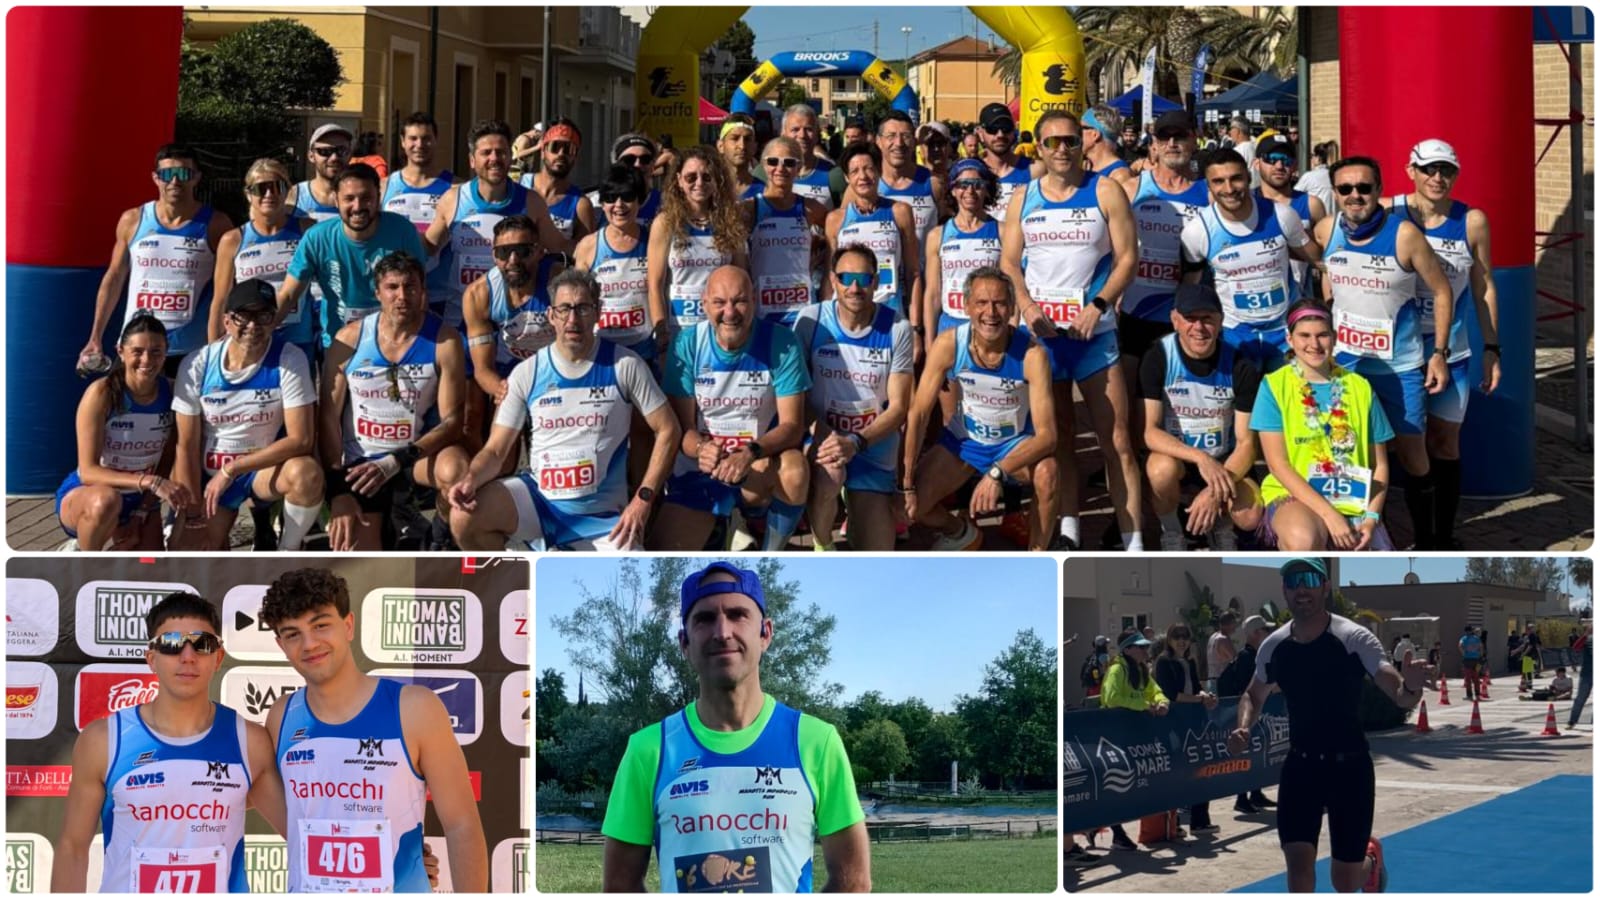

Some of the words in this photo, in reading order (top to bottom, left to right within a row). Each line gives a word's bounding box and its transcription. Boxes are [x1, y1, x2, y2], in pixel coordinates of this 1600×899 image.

[794, 52, 850, 62] BROOKS
[1028, 98, 1083, 113] Caraffa
[1138, 219, 1185, 235] Ranocc
[460, 237, 493, 248] Rano
[136, 255, 200, 270] Ranocchi
[239, 263, 290, 277] Ranoc
[1140, 263, 1180, 279] 102
[139, 293, 189, 311] 1029
[763, 288, 807, 304] 1022
[1246, 292, 1273, 309] 31
[599, 310, 645, 328] 1013
[1338, 327, 1389, 351] 1020
[819, 364, 882, 384] Ranocchi
[696, 394, 763, 407] Ranocchi
[537, 412, 609, 430] Ranocchi
[828, 414, 875, 433] 1024
[358, 420, 412, 440] 1026
[974, 423, 1002, 439] 35
[1189, 432, 1217, 448] 76
[542, 466, 593, 489] 1019
[1321, 478, 1353, 495] 45
[384, 600, 461, 623] THOMAS
[6, 630, 40, 638] TALIANA
[108, 648, 125, 657] A.I.
[394, 653, 409, 662] A.I.
[411, 653, 453, 662] MOMENT
[6, 693, 35, 706] ese
[286, 749, 316, 762] AVIS
[1127, 742, 1167, 758] DOMUS
[1135, 755, 1172, 776] MARE
[6, 768, 32, 785] TTÀ
[126, 771, 166, 787] AVIS
[289, 778, 384, 800] Ranocchi
[669, 779, 710, 796] AVIS
[1063, 791, 1091, 805] mare
[127, 799, 230, 821] Ranocchi
[343, 802, 383, 813] software
[190, 822, 227, 833] software
[671, 807, 787, 835] Ranocchi
[741, 833, 785, 845] software
[319, 842, 366, 874] 476
[153, 870, 202, 893] 477
